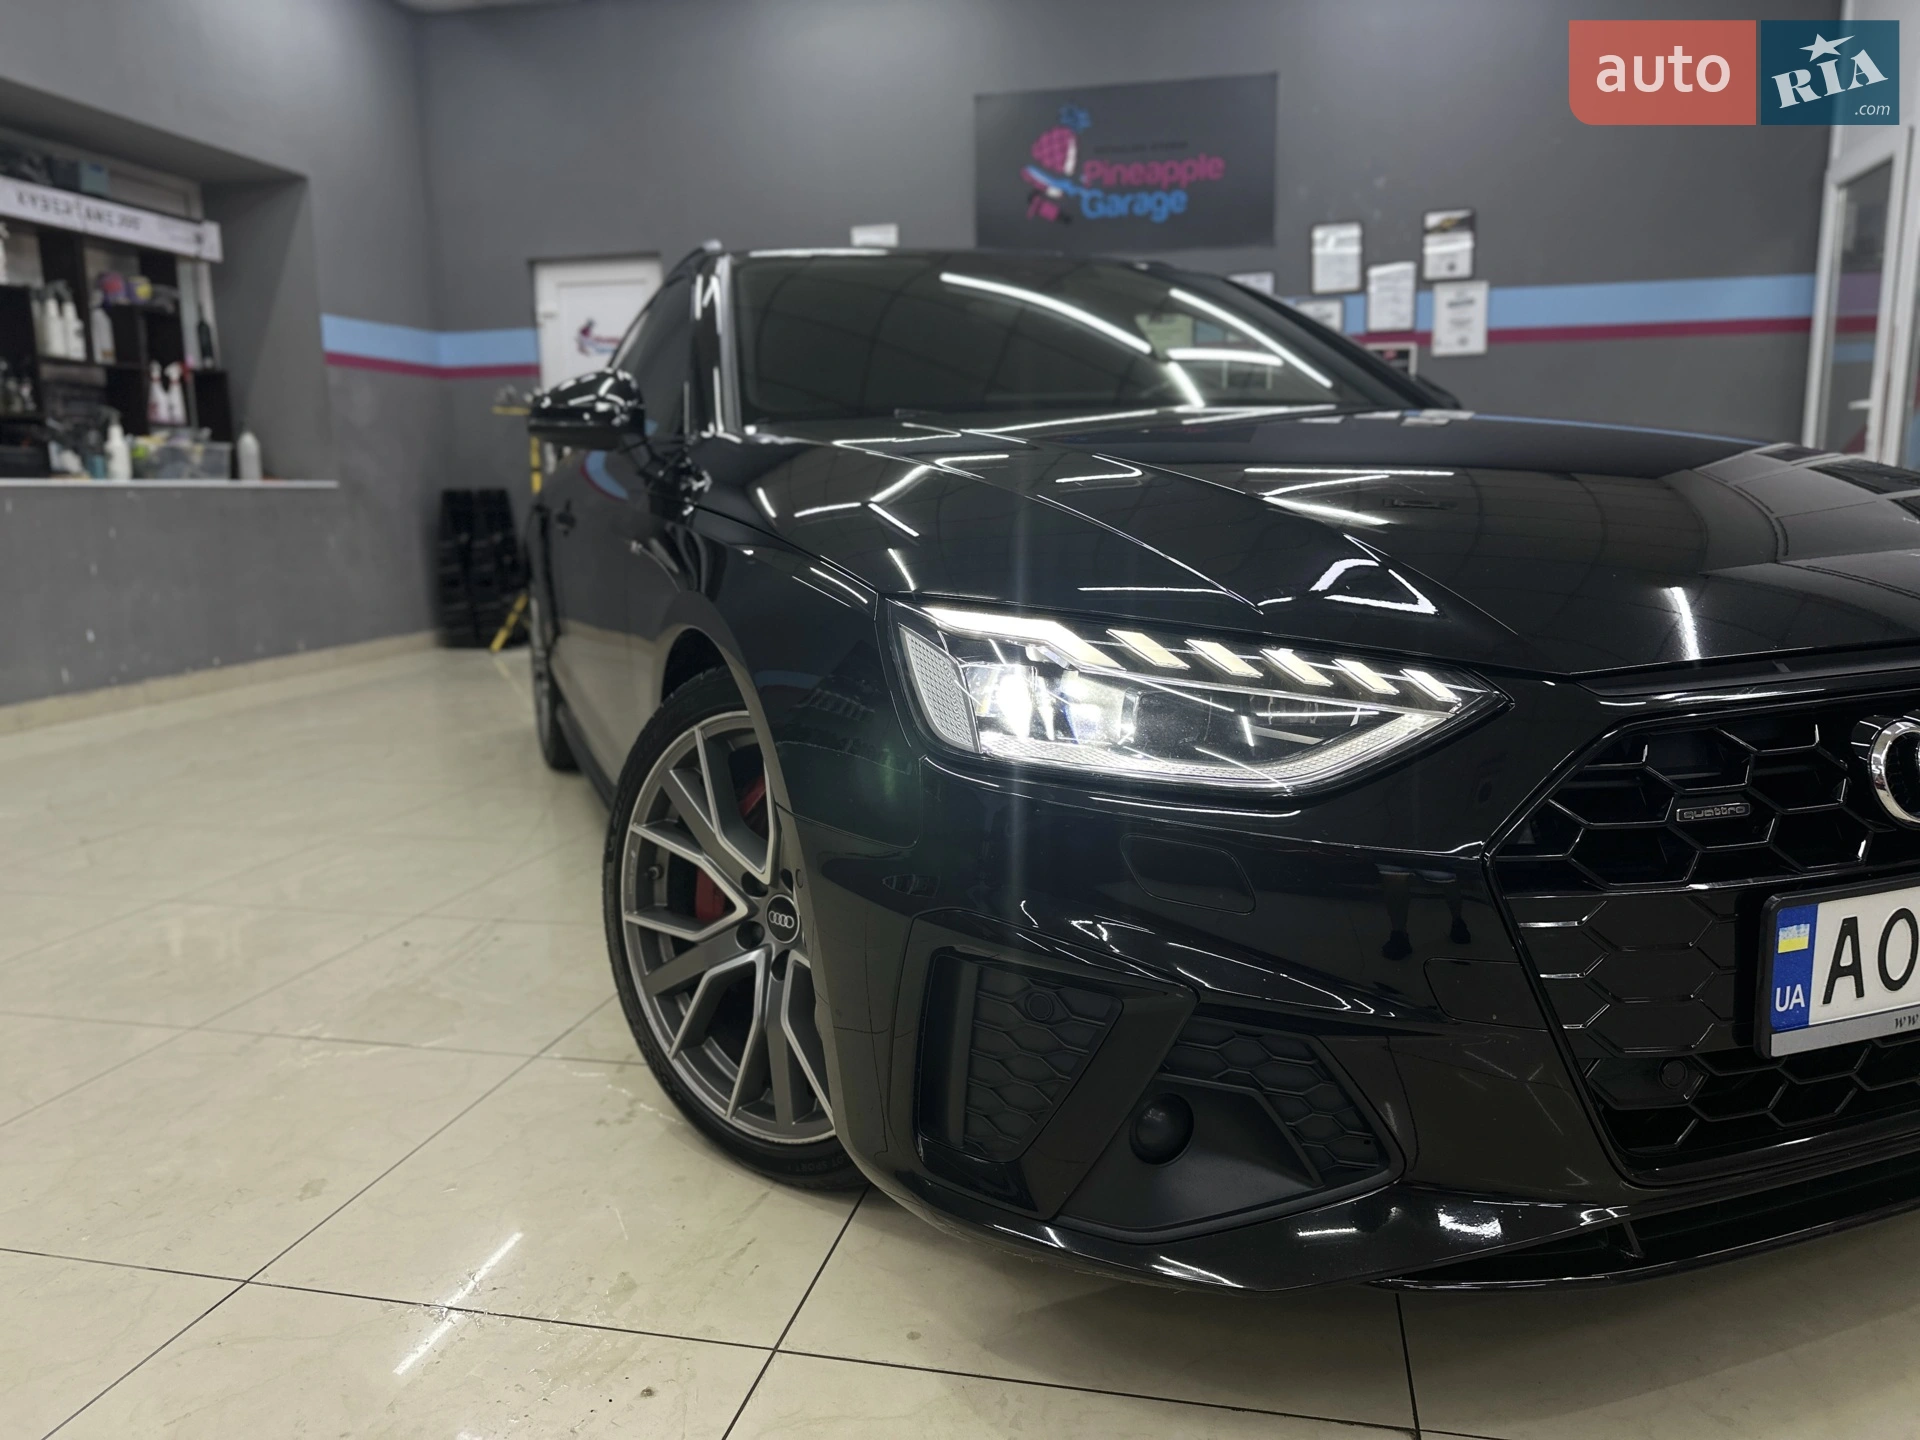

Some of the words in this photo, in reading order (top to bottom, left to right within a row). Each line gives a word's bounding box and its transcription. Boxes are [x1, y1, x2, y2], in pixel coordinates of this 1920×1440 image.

[1082, 152, 1225, 190] Pineapple
[1080, 188, 1188, 223] Garage
[1683, 805, 1746, 820] quattro
[1822, 907, 1919, 1005] AO
[1775, 983, 1806, 1012] UA
